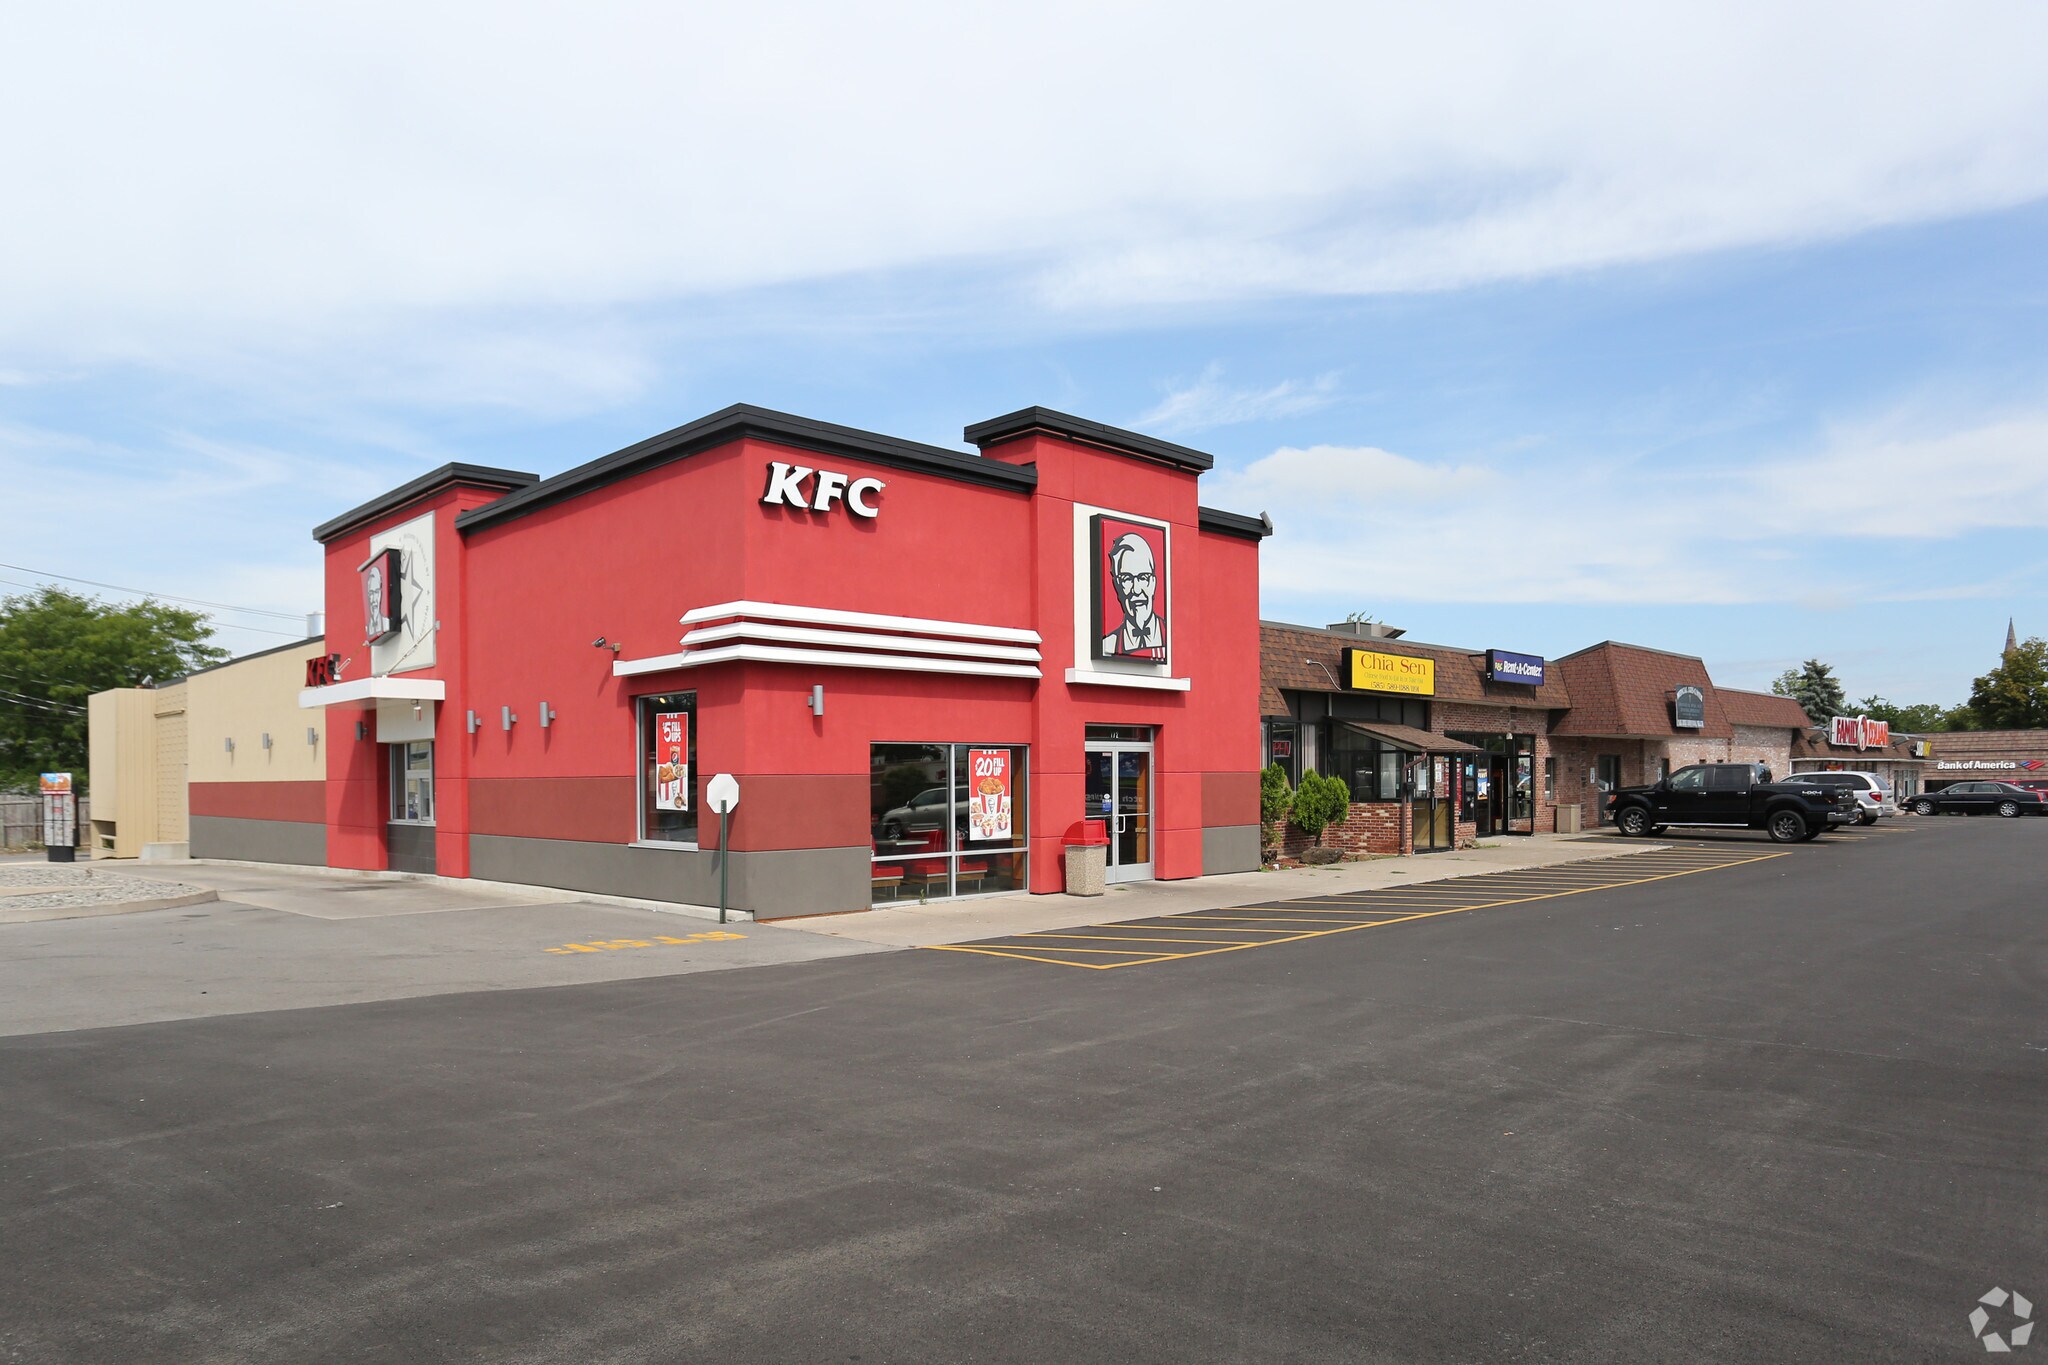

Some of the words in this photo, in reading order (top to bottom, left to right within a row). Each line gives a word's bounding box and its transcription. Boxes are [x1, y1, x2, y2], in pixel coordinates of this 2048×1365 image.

[762, 461, 886, 518] KFC
[305, 655, 340, 687] KFC
[1360, 653, 1394, 672] Chia
[1400, 658, 1426, 675] Sen
[1371, 681, 1385, 690] (585)
[1836, 718, 1859, 745] FAMILY
[993, 757, 1005, 767] FILL
[1937, 761, 1963, 770] Bank
[1963, 761, 1973, 769] of
[1974, 761, 2015, 769] America
[993, 767, 1002, 776] UP
